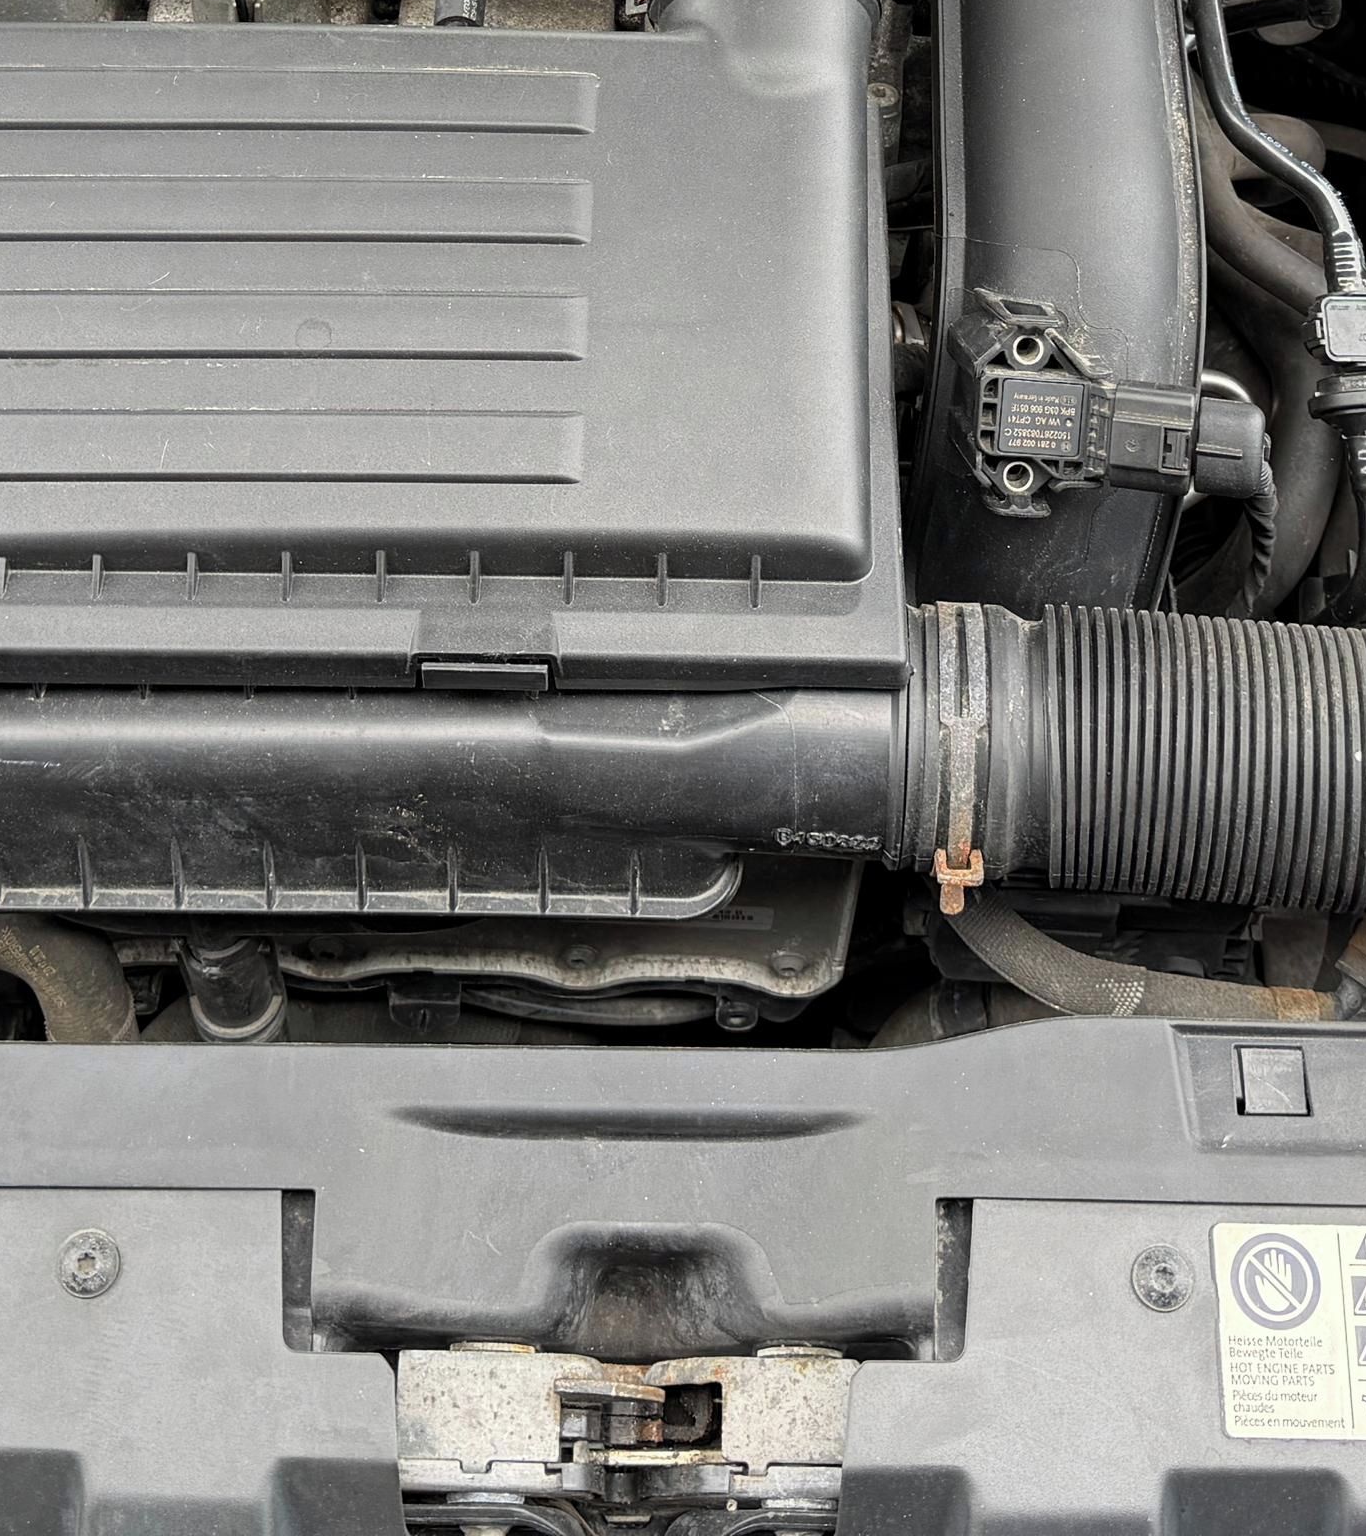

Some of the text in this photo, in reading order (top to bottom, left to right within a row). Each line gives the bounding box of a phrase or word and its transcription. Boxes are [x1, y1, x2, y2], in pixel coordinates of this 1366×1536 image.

[1013, 392, 1038, 402] Germany
[1045, 396, 1060, 404] Made
[1035, 416, 1047, 426] AG
[1048, 417, 1061, 426] VW
[1003, 428, 1012, 436] C
[1008, 438, 1022, 447] 977
[1023, 439, 1036, 447] 002
[1037, 440, 1050, 448] 281
[1228, 1335, 1323, 1348] Heisse Motorteile
[1229, 1347, 1304, 1362] Bewegte Teile
[1230, 1362, 1335, 1376] HOT ENGINE PARTS
[1230, 1375, 1315, 1387] MOVING PARTS
[1232, 1389, 1318, 1403] Pièces du moteur
[1233, 1401, 1275, 1414] chaudes
[1234, 1415, 1346, 1429] Pièces en mouvement
